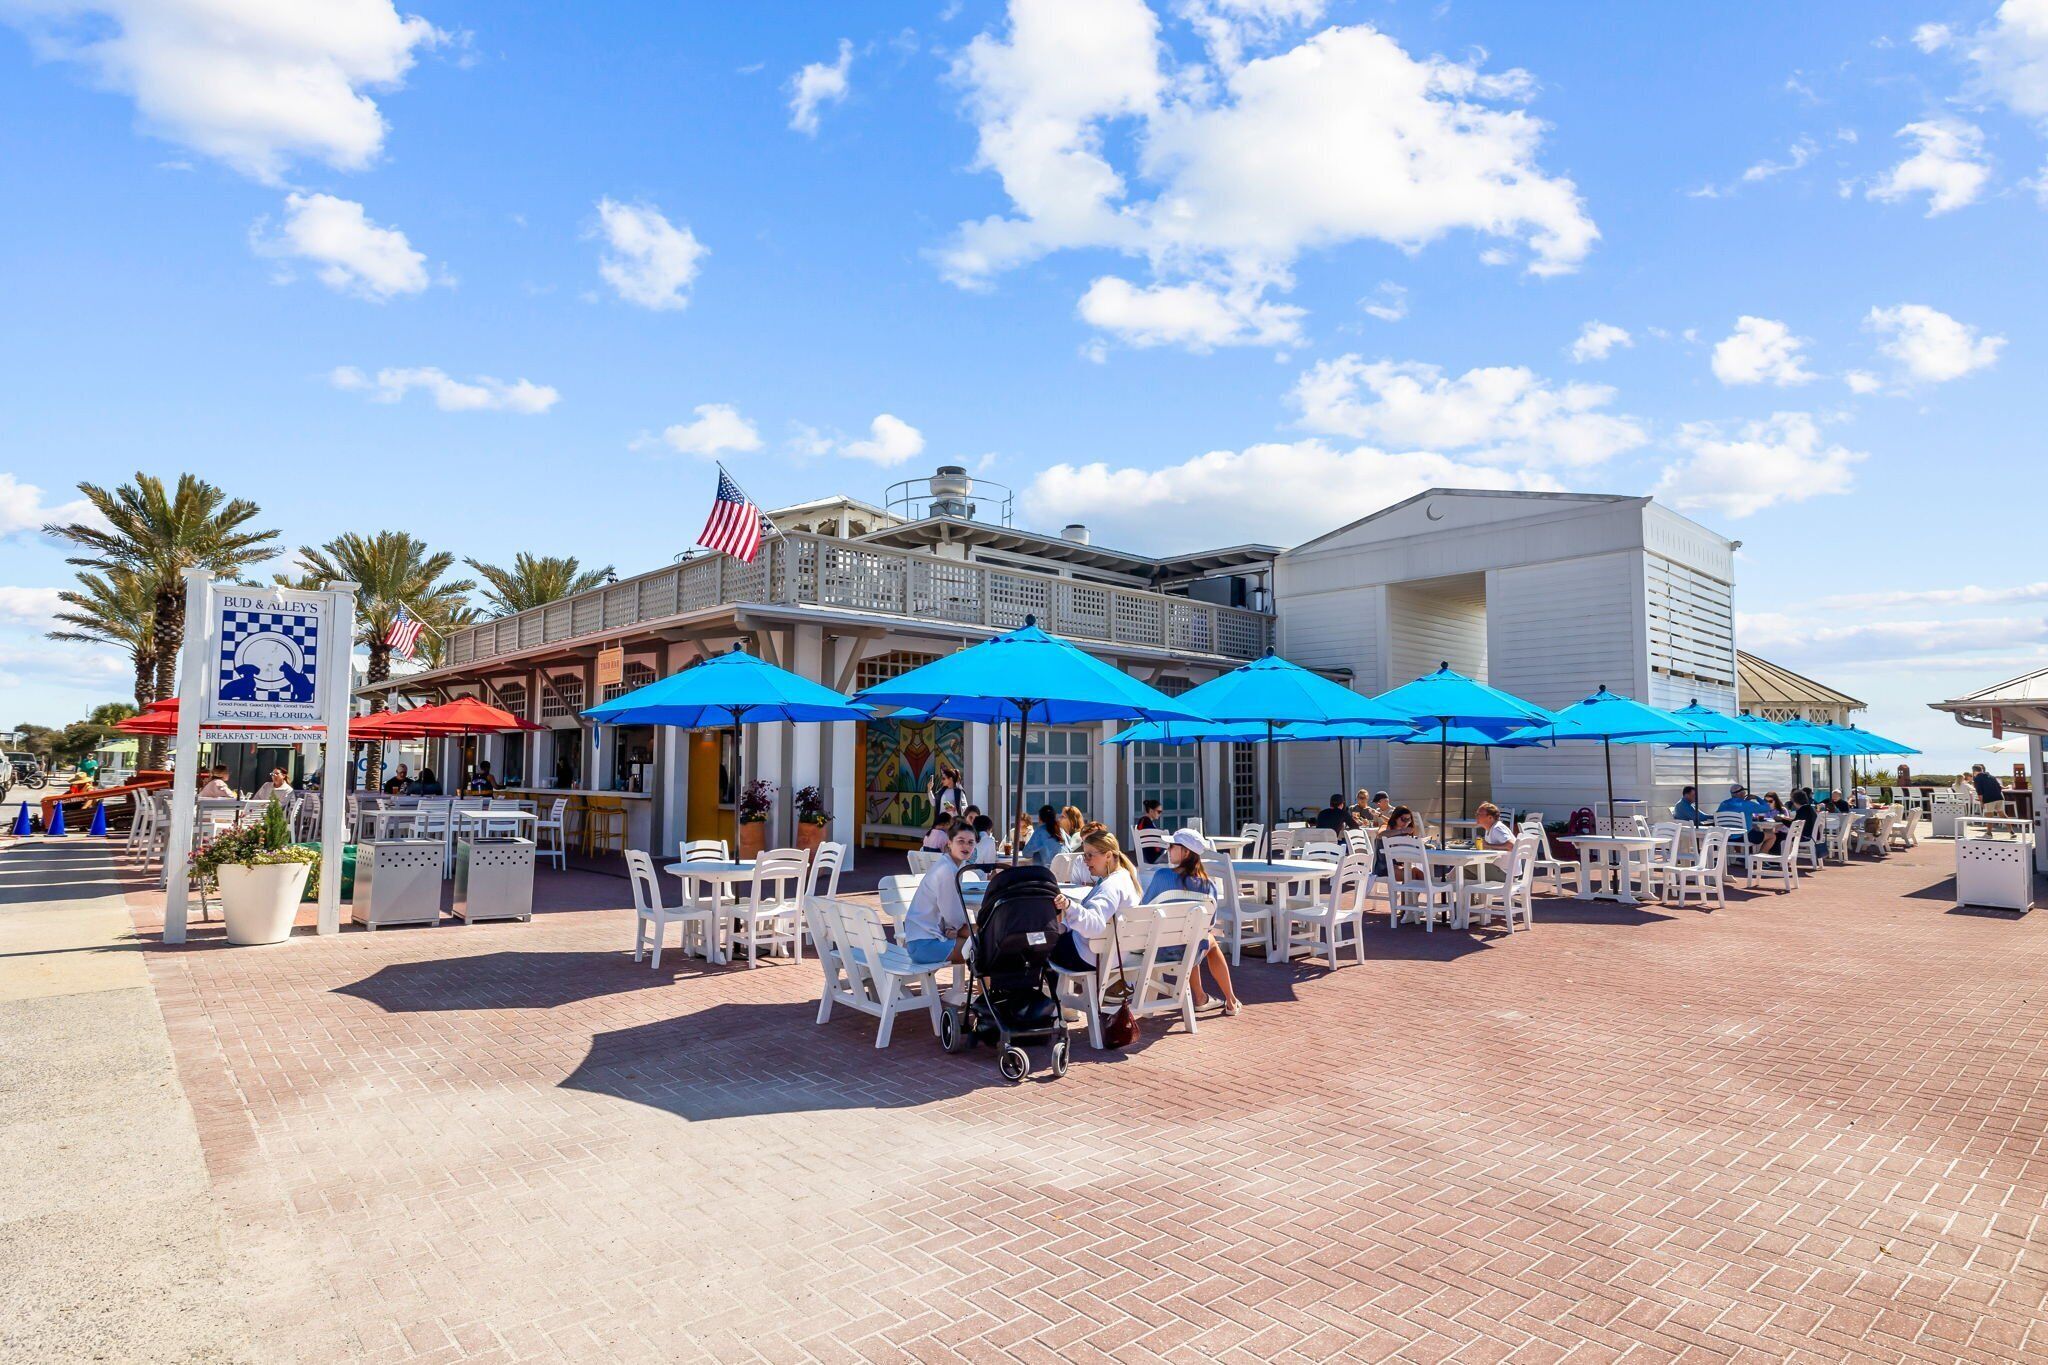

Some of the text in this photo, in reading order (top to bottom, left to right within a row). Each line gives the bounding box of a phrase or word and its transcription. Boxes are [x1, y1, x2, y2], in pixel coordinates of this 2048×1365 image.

[224, 596, 318, 613] BUD & ALLEY'S
[217, 710, 314, 720] SEASIDE, FLORIDA
[205, 732, 254, 740] BREAKFAST
[293, 733, 322, 741] DINNER
